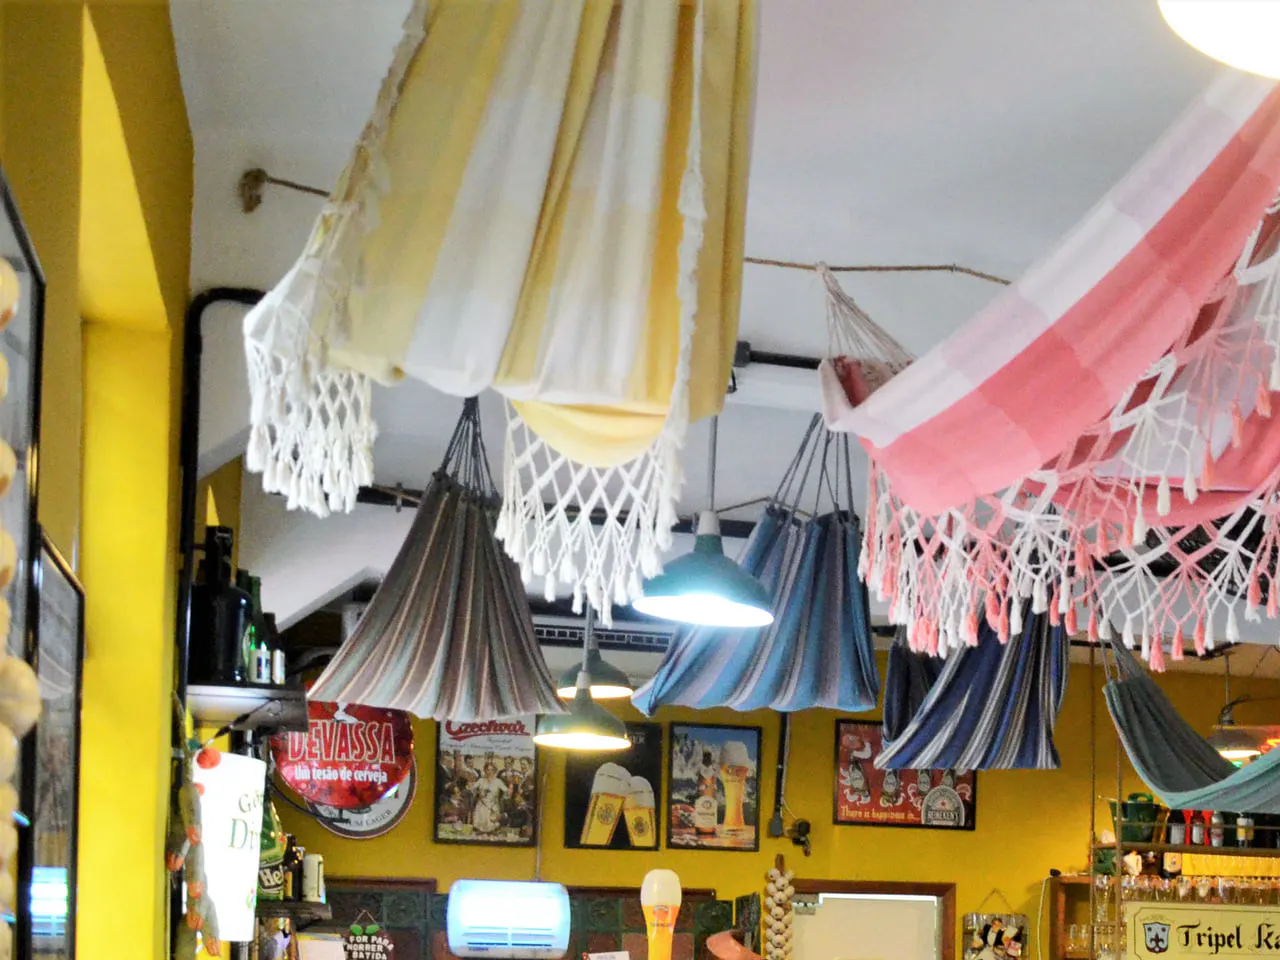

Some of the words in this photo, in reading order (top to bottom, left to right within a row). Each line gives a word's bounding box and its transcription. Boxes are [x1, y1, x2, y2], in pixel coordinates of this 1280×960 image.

[287, 719, 396, 764] DEVASSA
[294, 763, 311, 780] Um
[311, 765, 339, 781] tesão
[340, 766, 353, 782] de
[353, 767, 388, 785] cerveja
[365, 809, 393, 826] LAGER
[349, 935, 369, 943] FOR
[370, 935, 395, 952] PARA
[1176, 921, 1242, 955] Tripel
[346, 943, 384, 953] MORRER
[352, 951, 387, 960] BATIDA
